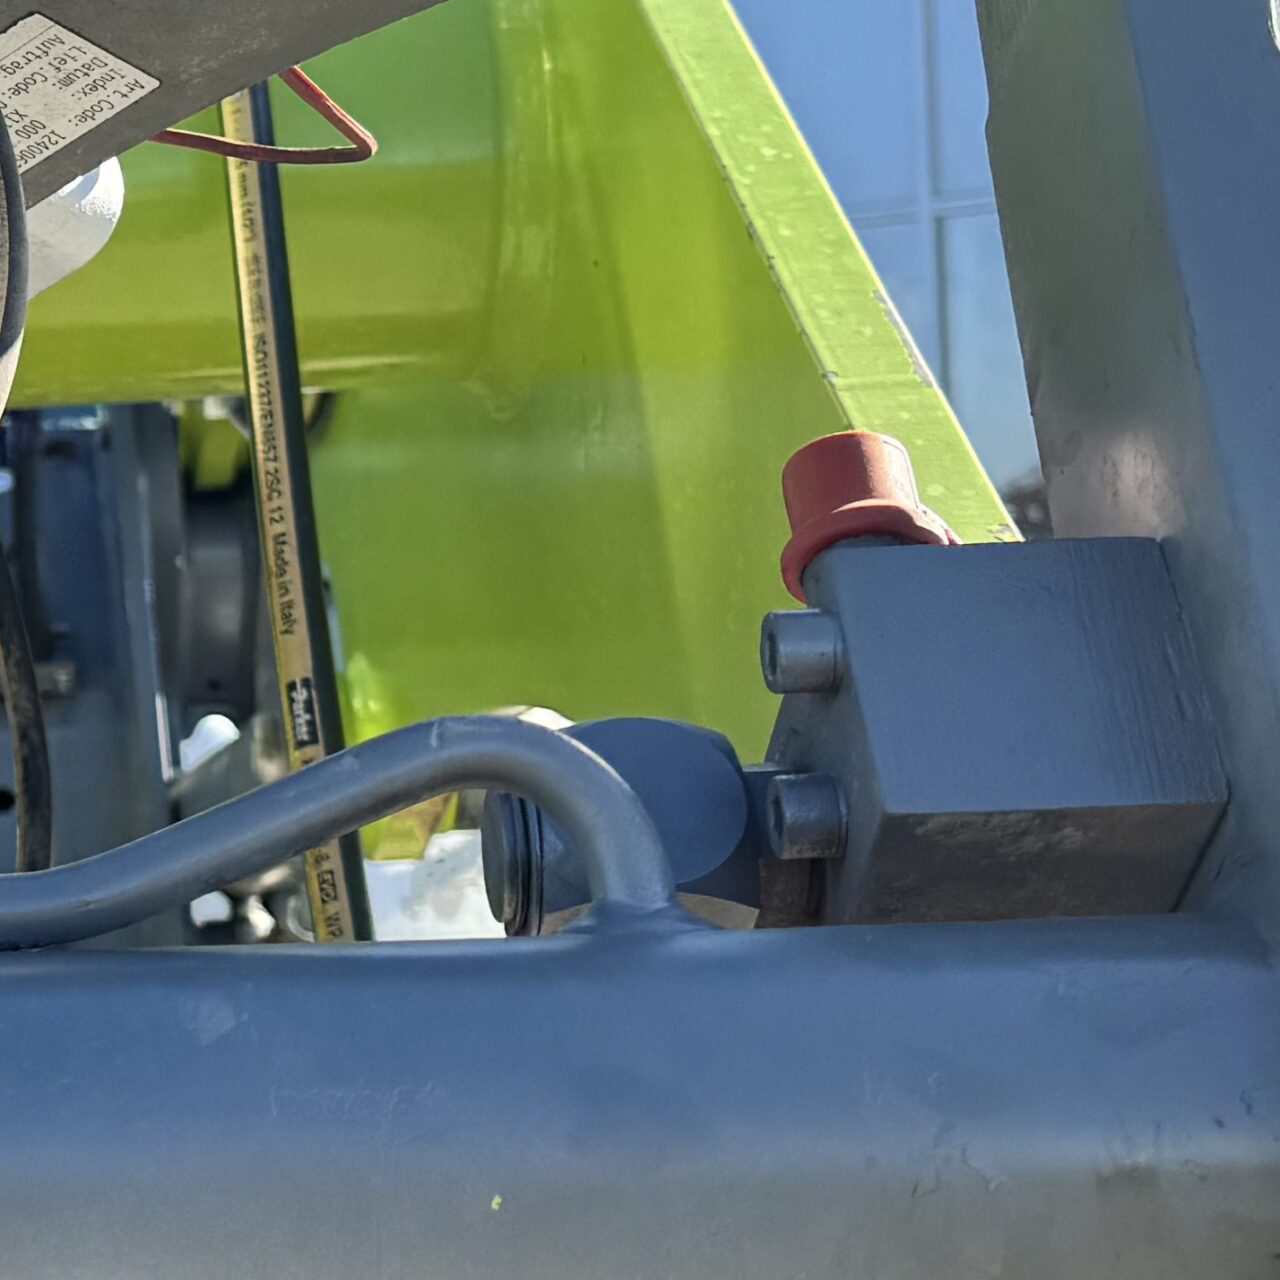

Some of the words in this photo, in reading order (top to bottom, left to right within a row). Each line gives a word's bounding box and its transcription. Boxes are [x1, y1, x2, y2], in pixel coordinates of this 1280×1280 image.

[52, 57, 108, 90] Datum:
[72, 69, 125, 100] Index:
[69, 79, 145, 126] Art.Code:
[16, 130, 66, 168] 124006
